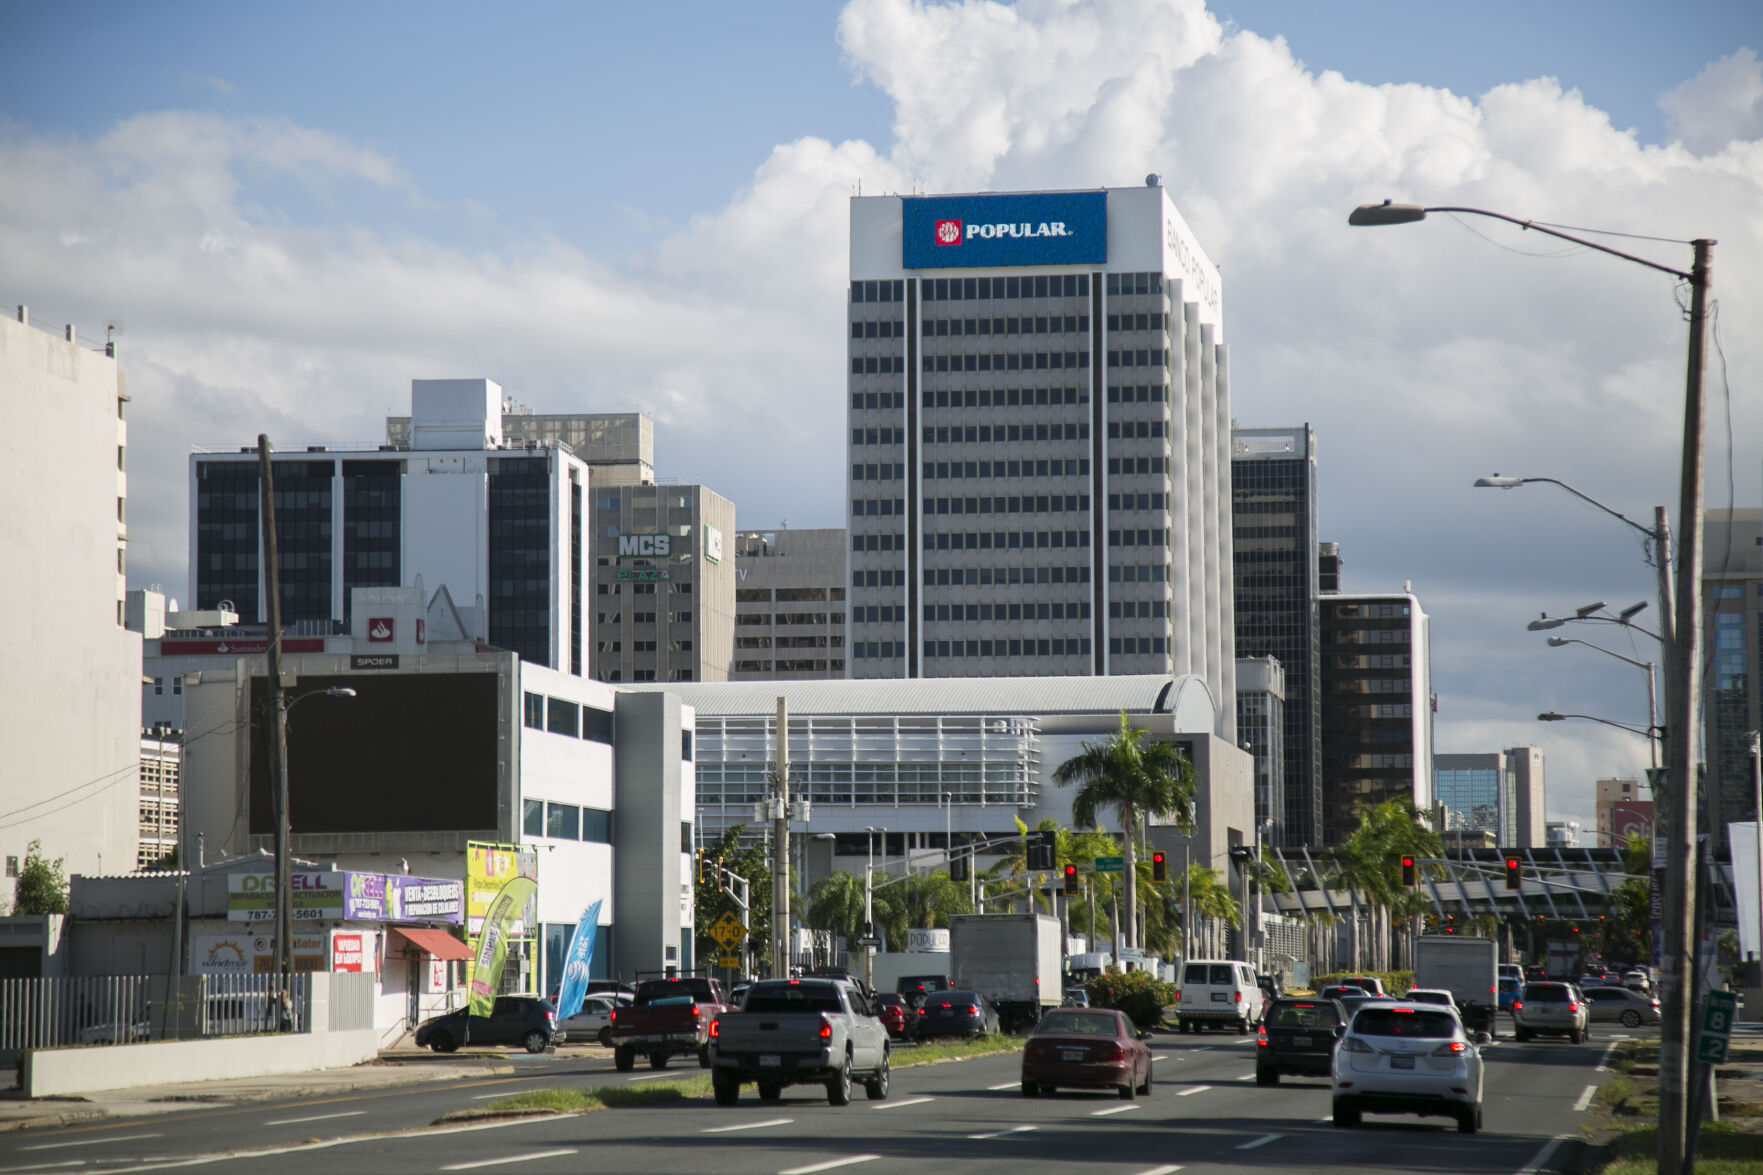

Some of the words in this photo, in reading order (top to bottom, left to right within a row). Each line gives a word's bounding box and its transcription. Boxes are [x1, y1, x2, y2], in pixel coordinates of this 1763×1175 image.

[966, 221, 1068, 239] POPULAR
[1167, 218, 1190, 274] BANCO
[619, 534, 670, 557] MCS
[617, 568, 670, 581] PLAZA
[229, 643, 267, 654] Santander
[241, 874, 328, 891] DRELL
[404, 886, 422, 902] VENTA
[247, 909, 323, 920] 787-7-5601
[714, 926, 740, 938] 17-0
[481, 929, 499, 968] SIMPLE
[1710, 1011, 1726, 1030] 8
